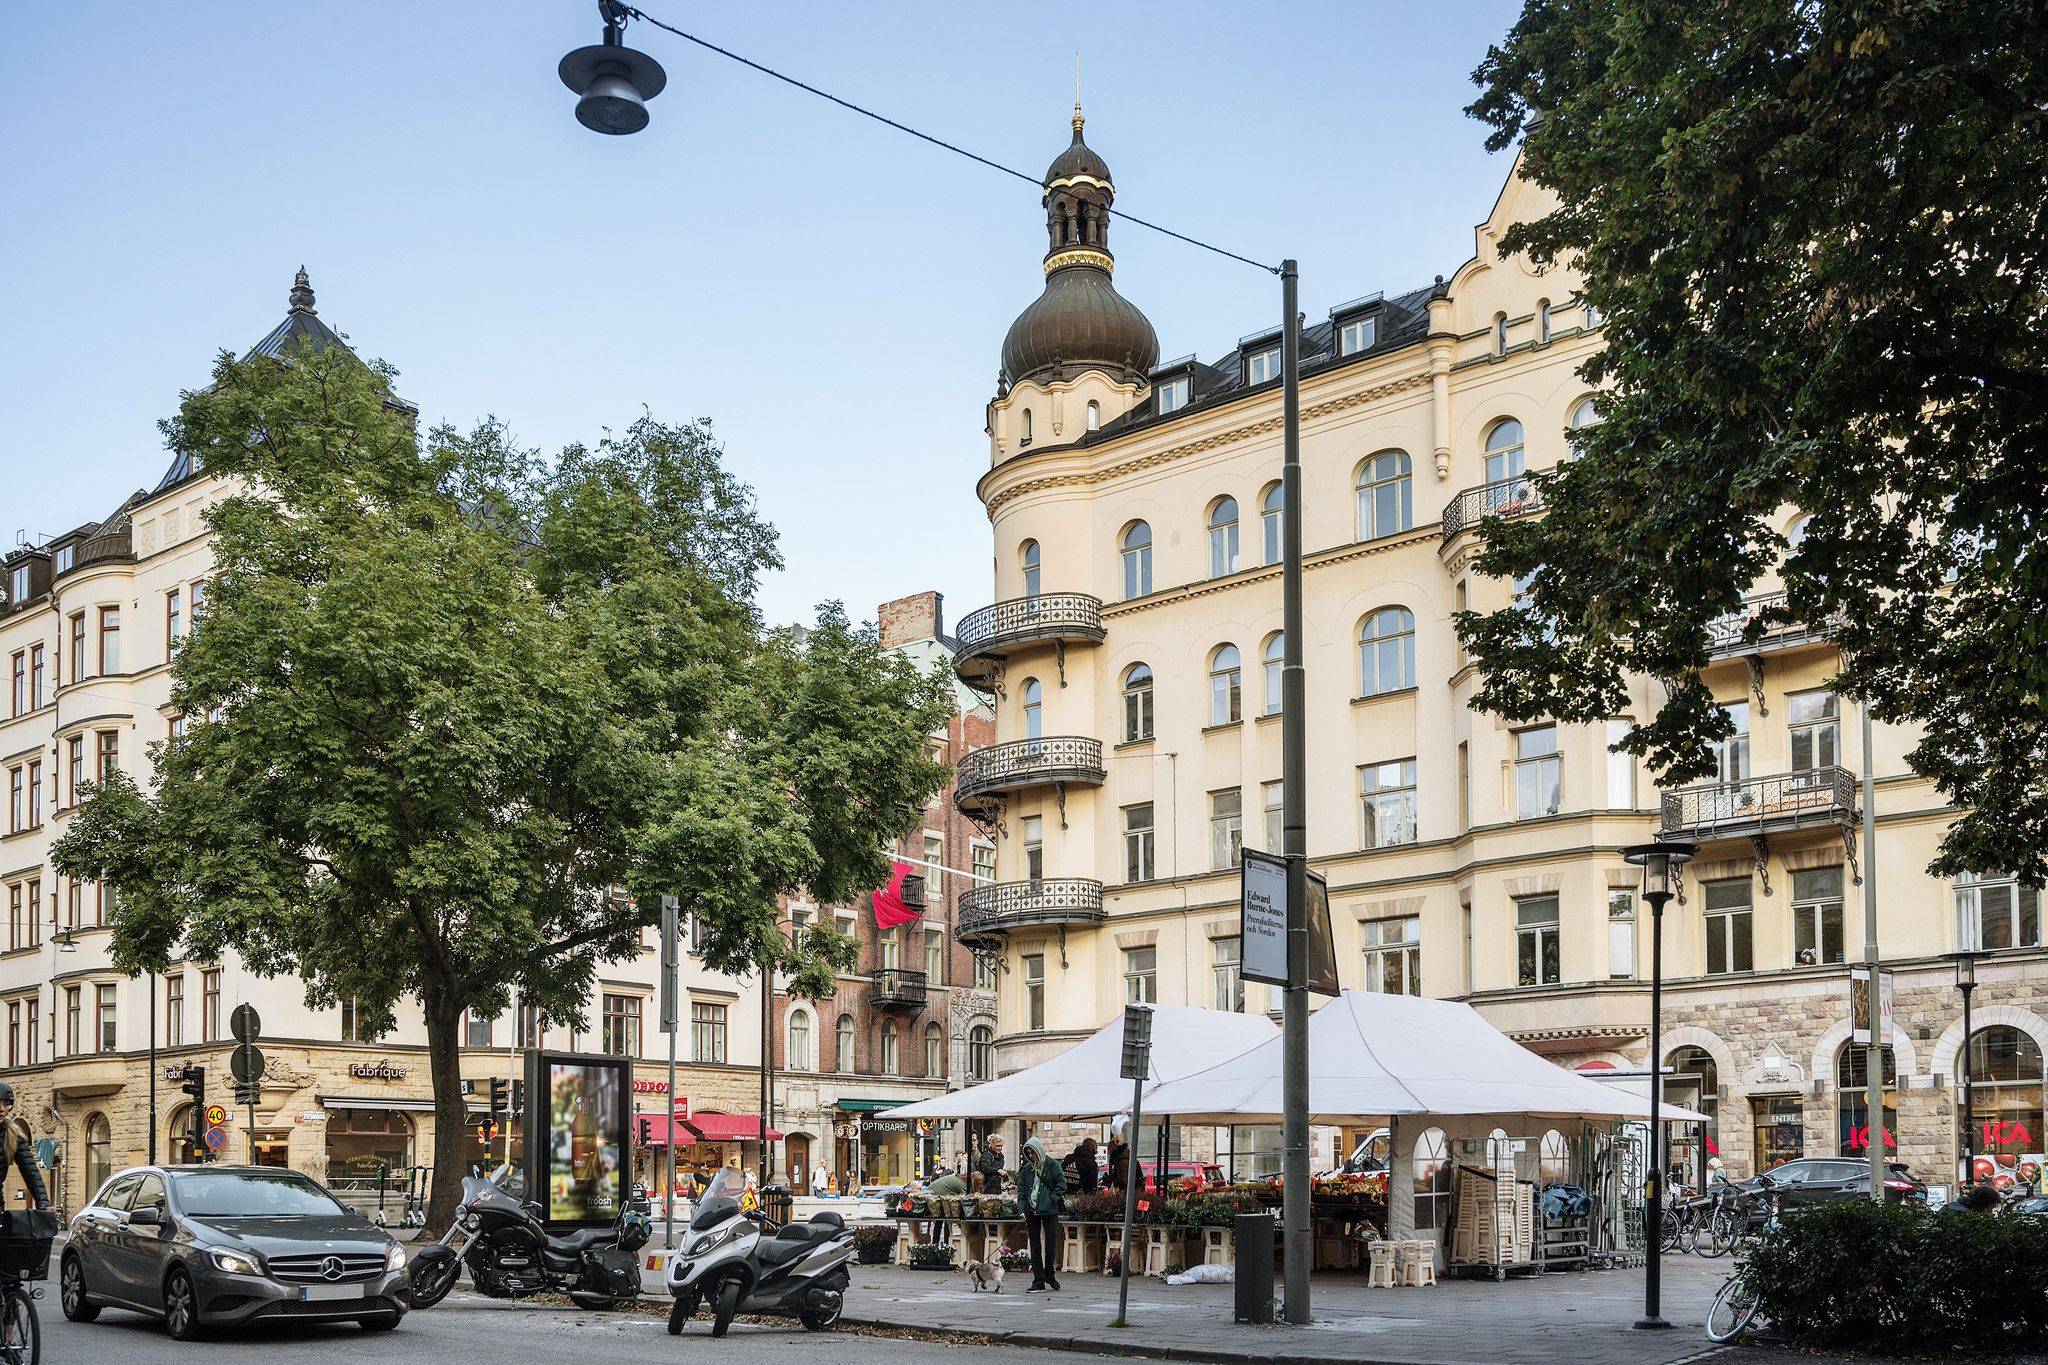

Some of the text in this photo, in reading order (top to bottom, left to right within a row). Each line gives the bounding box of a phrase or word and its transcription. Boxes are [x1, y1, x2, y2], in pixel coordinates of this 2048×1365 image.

[1247, 890, 1270, 904] Edward
[1247, 901, 1284, 917] Burne-Jones
[351, 1059, 407, 1079] Fabrique
[208, 1111, 223, 1120] 40
[1771, 1114, 1797, 1122] ENTRÉ
[1983, 1120, 2033, 1145] ICA
